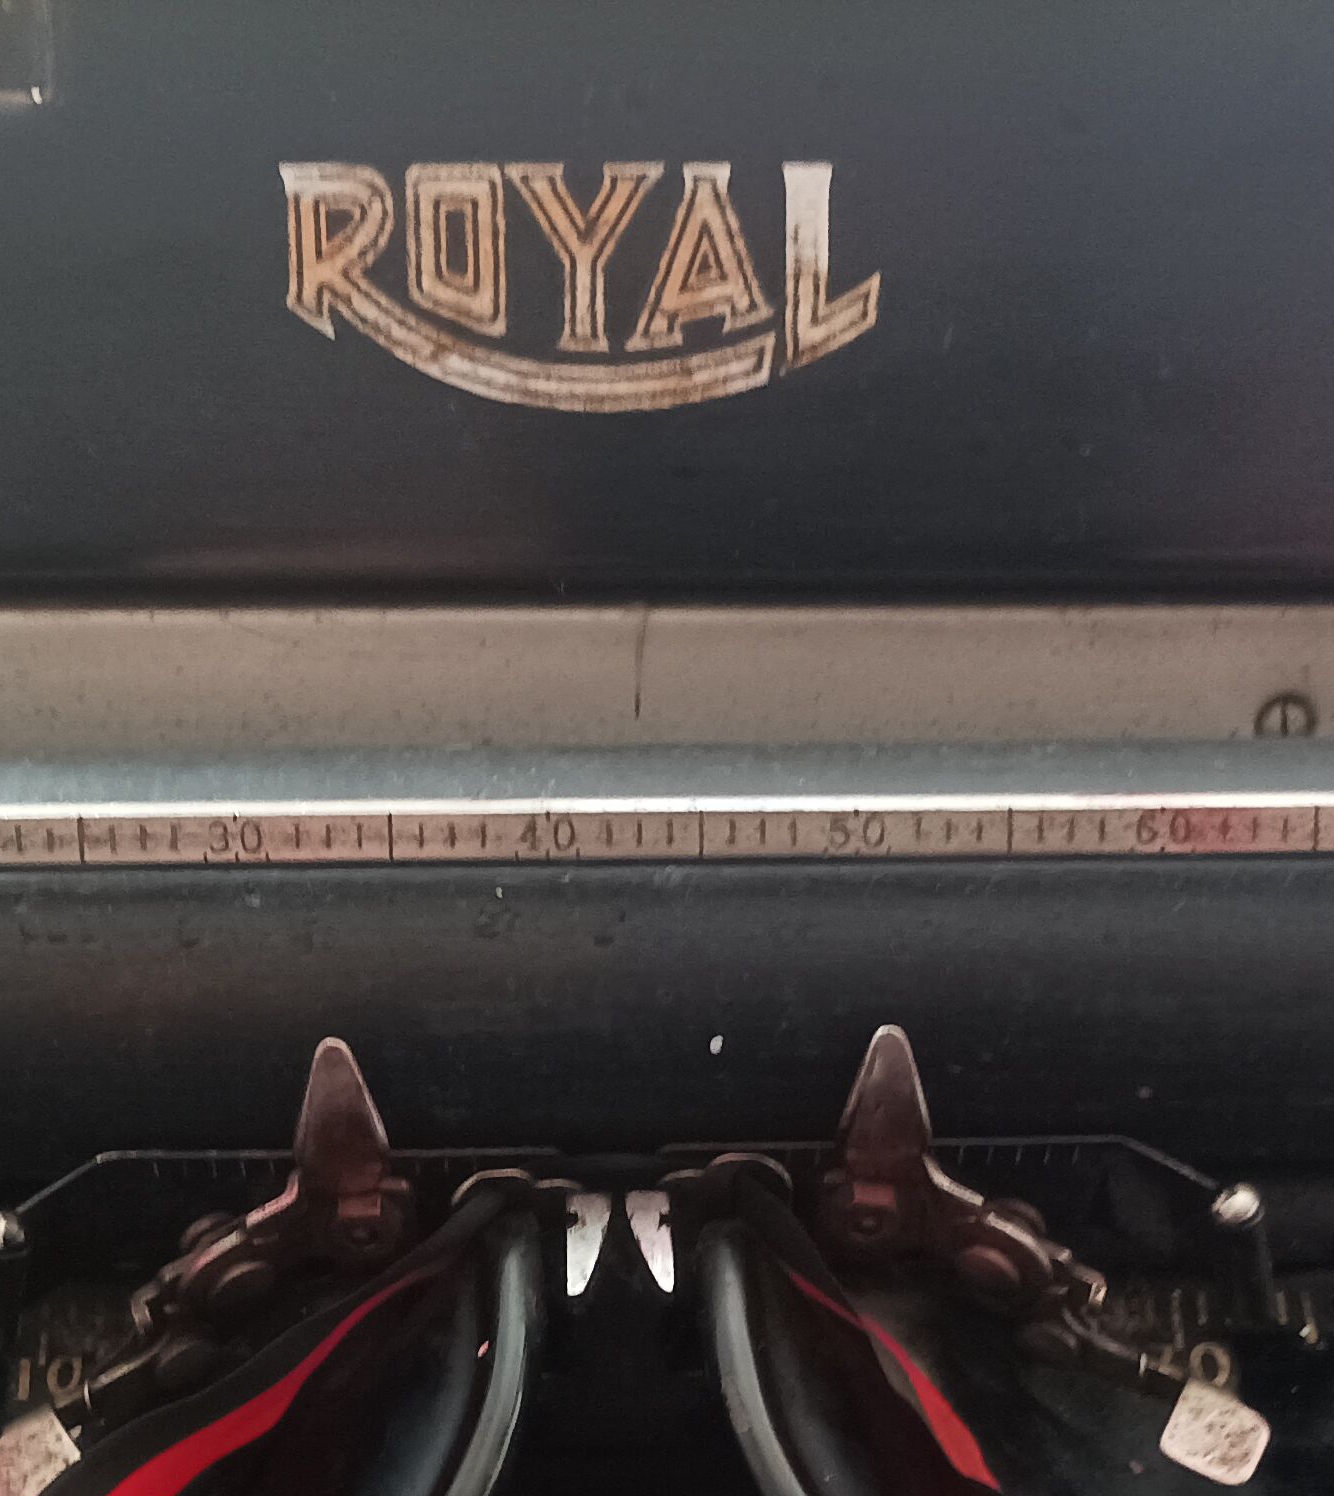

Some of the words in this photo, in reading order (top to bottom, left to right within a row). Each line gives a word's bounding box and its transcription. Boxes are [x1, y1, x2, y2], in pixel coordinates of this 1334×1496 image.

[279, 160, 881, 413] ROYAL
[208, 819, 262, 853] 30
[517, 813, 576, 852] 40
[829, 813, 886, 849] 50
[1136, 810, 1191, 846] 60
